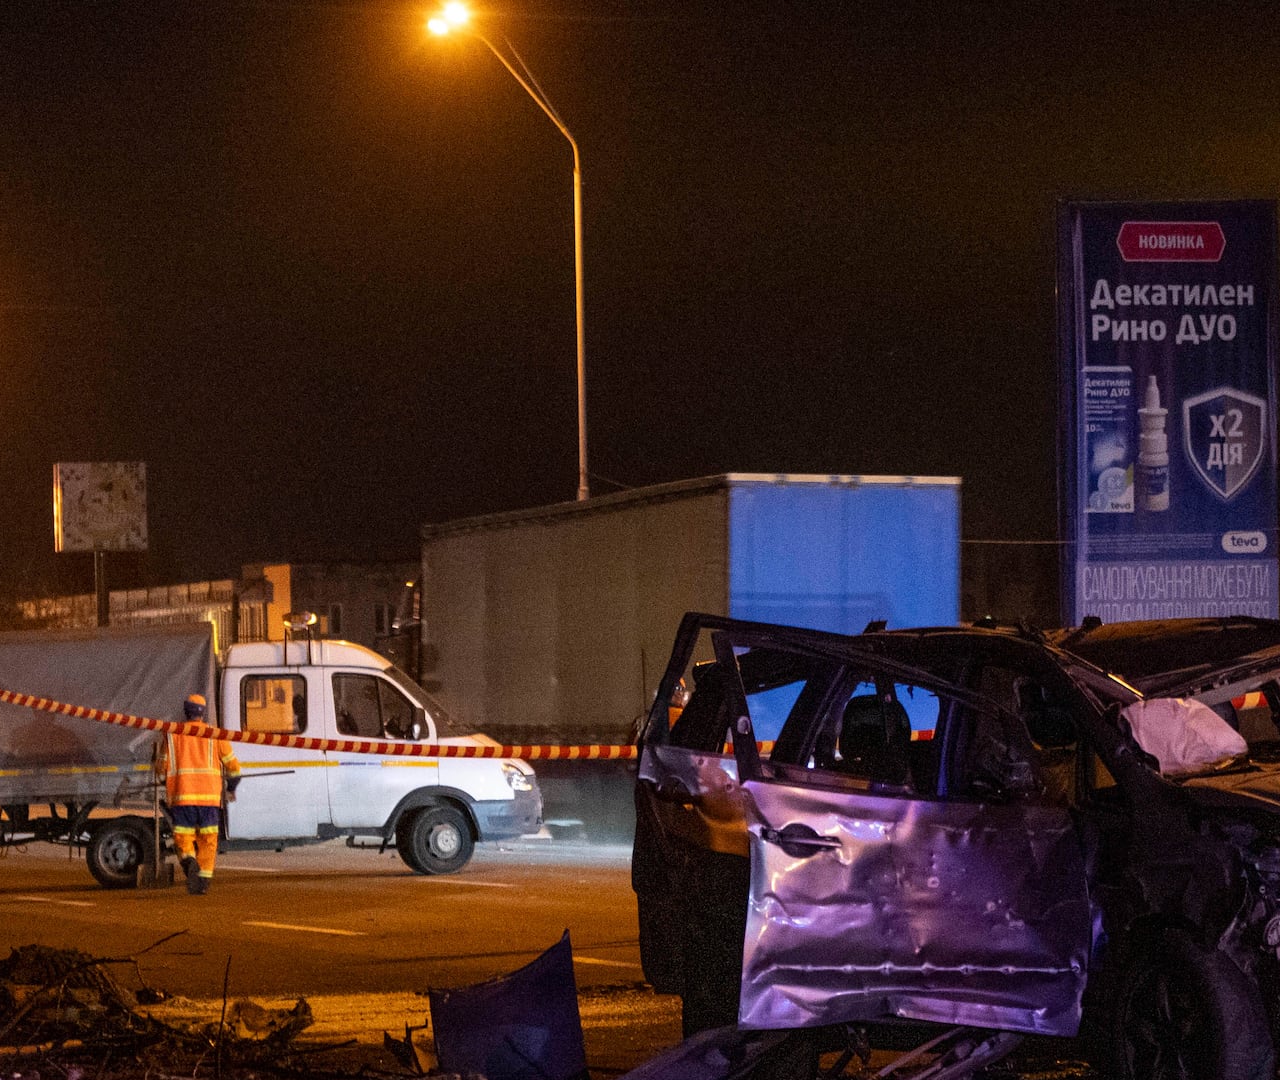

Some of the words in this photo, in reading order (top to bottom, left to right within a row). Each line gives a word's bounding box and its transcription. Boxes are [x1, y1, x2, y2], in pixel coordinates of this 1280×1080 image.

[1138, 234, 1205, 249] НОВИНКА
[1090, 279, 1254, 310] Декатилен
[1091, 314, 1167, 341] Рино
[1175, 314, 1237, 345] ДУО
[1085, 378, 1131, 387] Декатилен
[1110, 388, 1130, 398] ДУО
[1231, 535, 1259, 547] teva
[1083, 566, 1192, 600] САМОЛІКУВАННЯ
[1193, 565, 1234, 599] МОЖЕ
[1237, 565, 1270, 599] БУТИ
